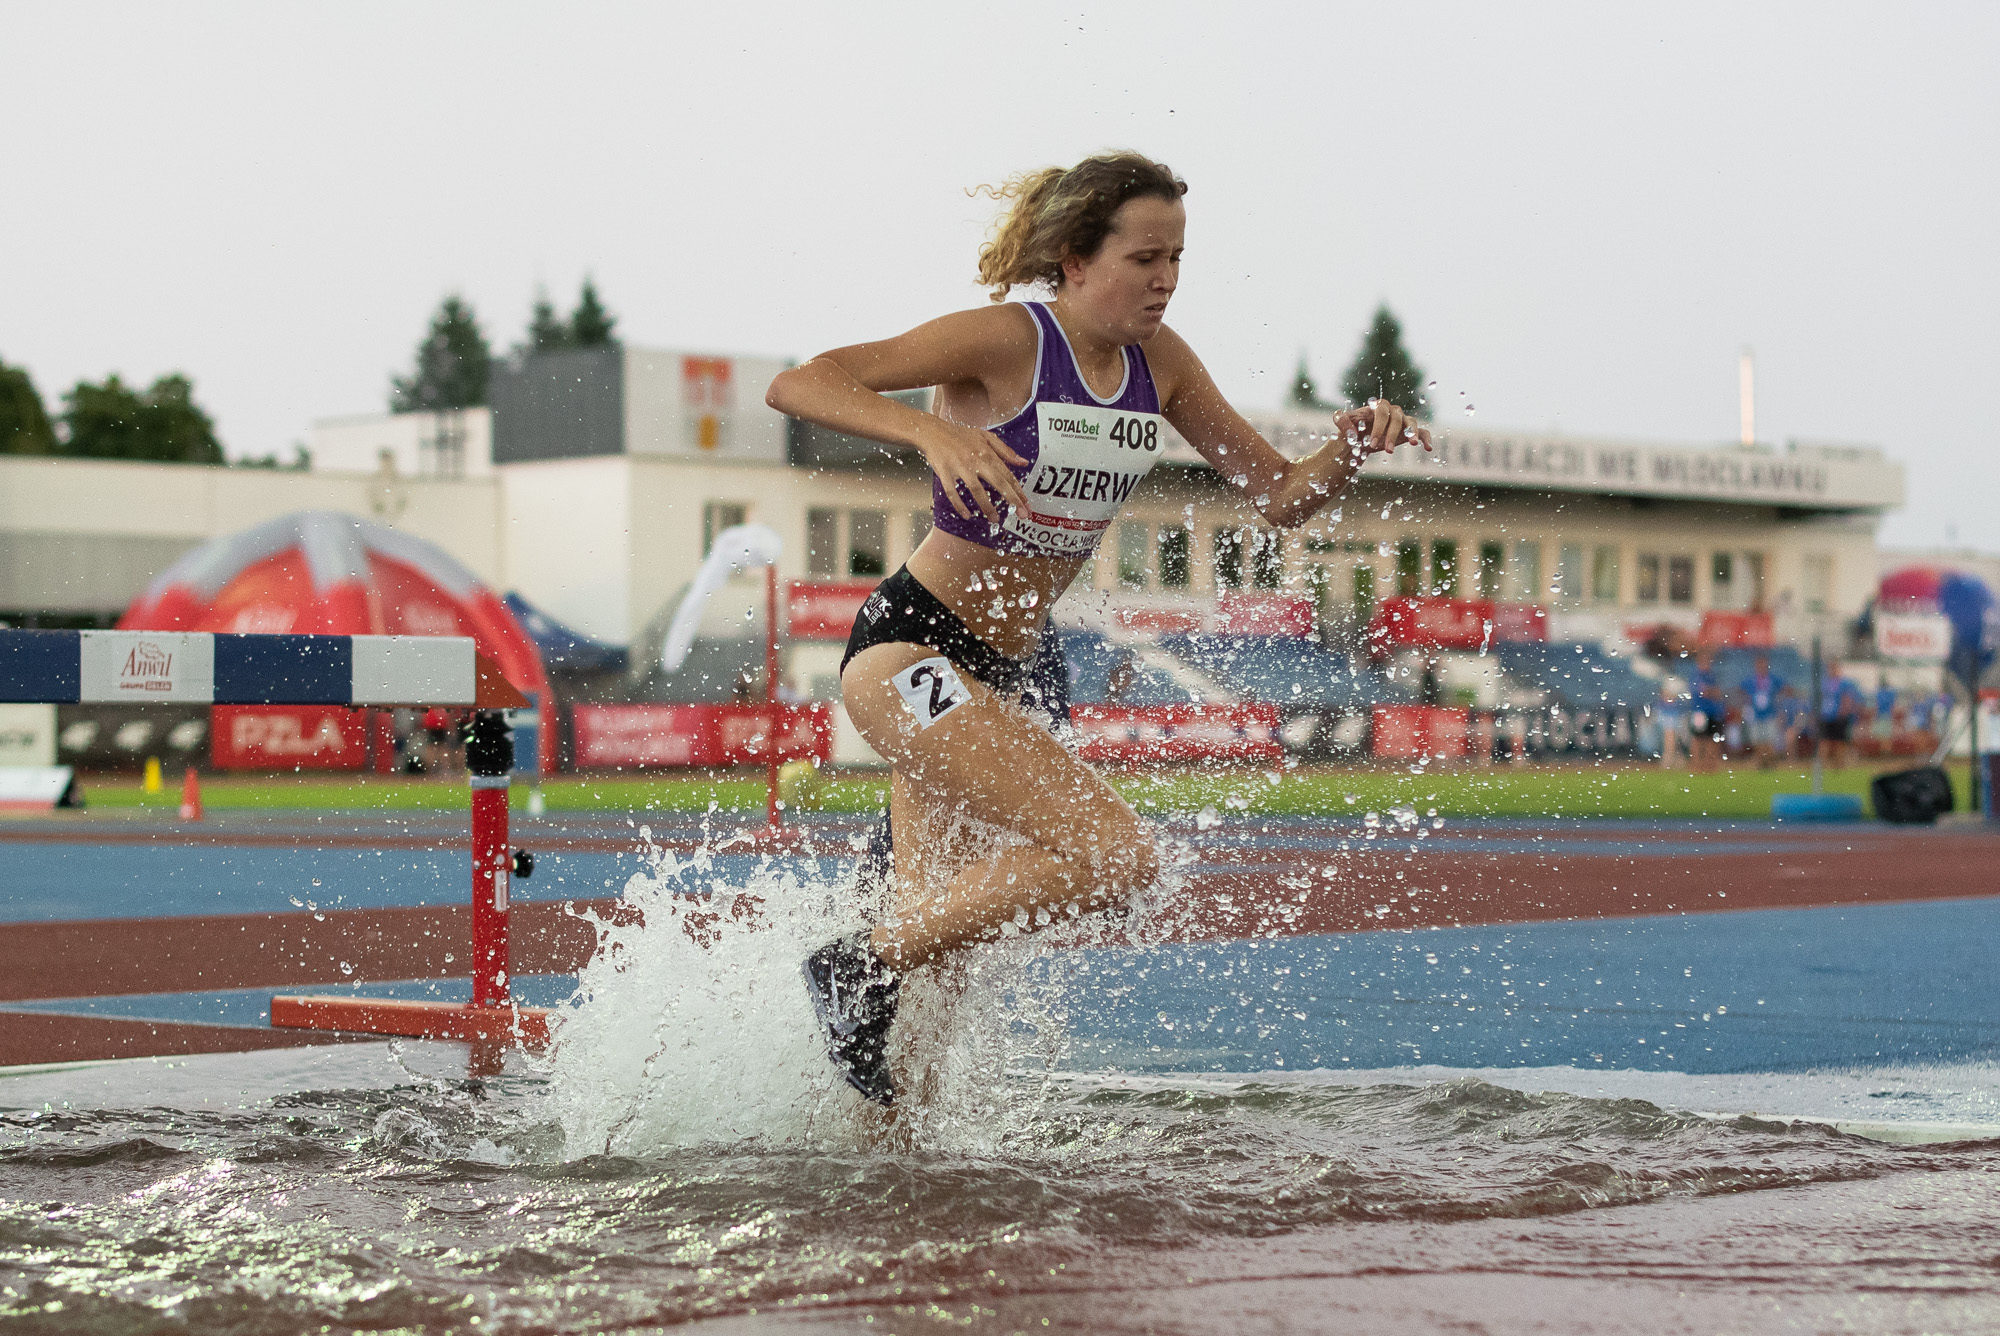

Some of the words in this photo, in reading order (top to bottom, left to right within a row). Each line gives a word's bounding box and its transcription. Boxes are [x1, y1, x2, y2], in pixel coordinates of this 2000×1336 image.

[1047, 417, 1100, 436] TOTALbet
[1109, 416, 1158, 452] 408
[120, 646, 172, 677] Anwil
[911, 665, 959, 719] 2
